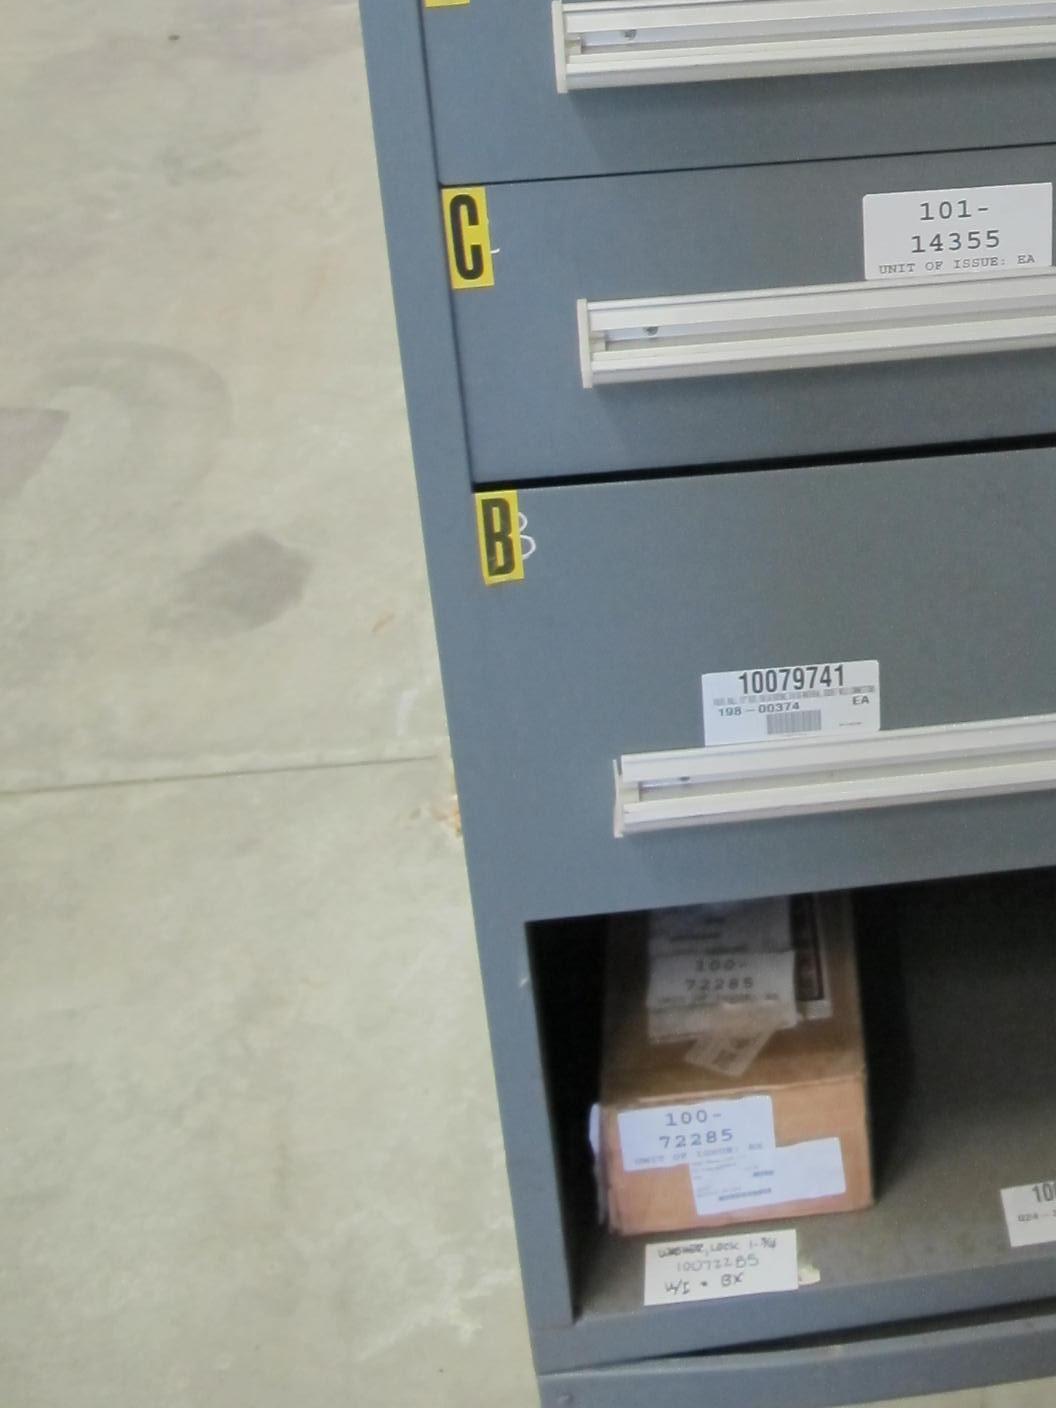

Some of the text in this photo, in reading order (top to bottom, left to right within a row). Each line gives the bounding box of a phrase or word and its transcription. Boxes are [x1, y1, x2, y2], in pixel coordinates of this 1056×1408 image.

[919, 199, 989, 221] 101-
[449, 194, 484, 280] C
[911, 229, 1000, 253] 14355
[879, 254, 1036, 275] UNIT OF ISSUE: EA
[481, 497, 515, 577] B
[738, 664, 844, 695] 10079741
[852, 695, 870, 706] EA
[665, 1109, 722, 1127] 100-
[659, 1129, 734, 1150] 72285
